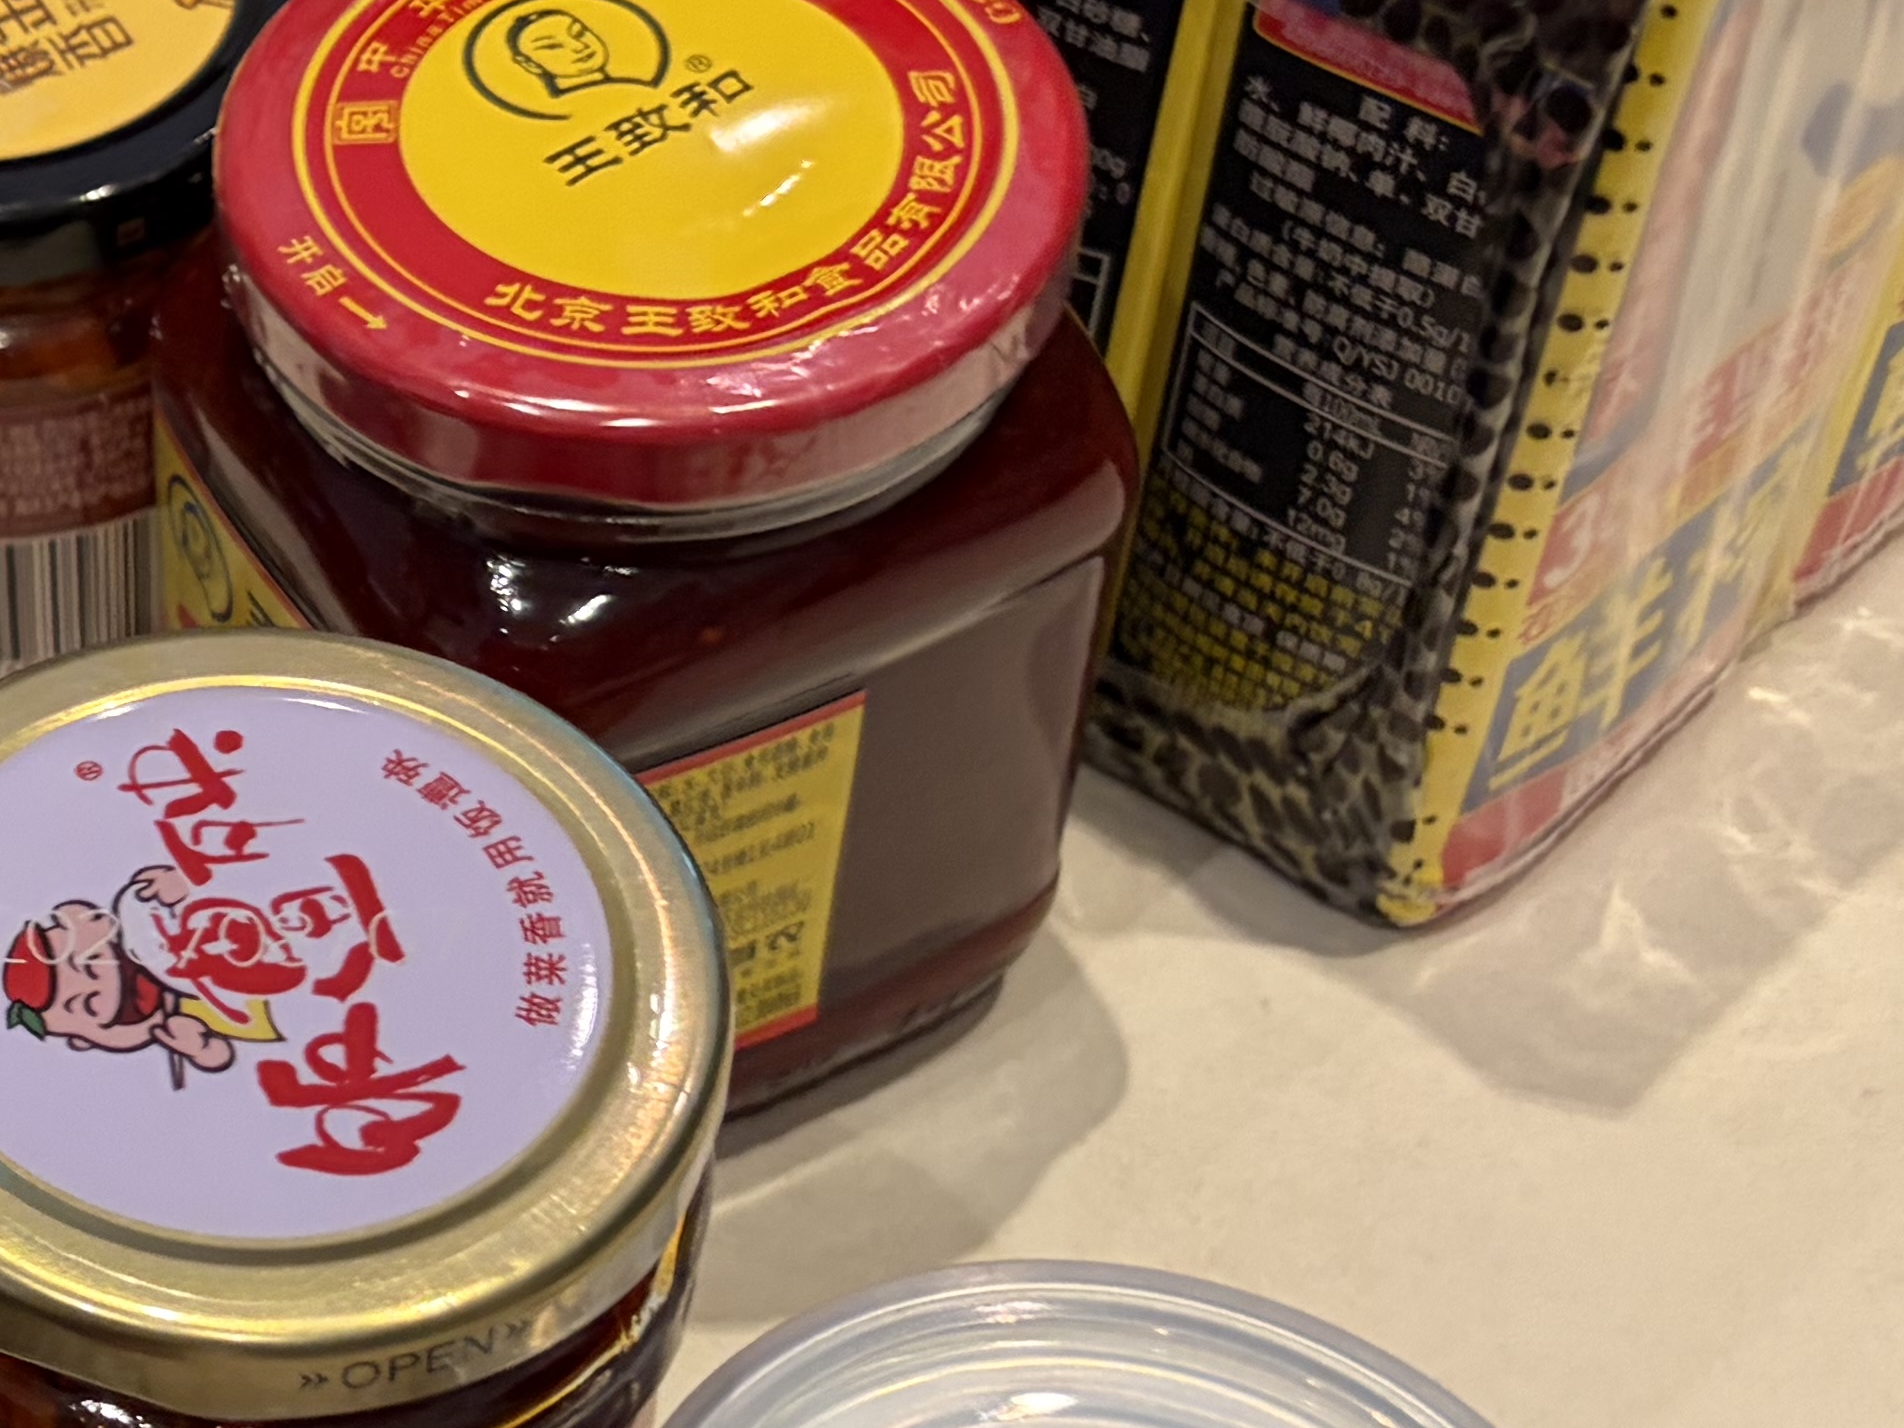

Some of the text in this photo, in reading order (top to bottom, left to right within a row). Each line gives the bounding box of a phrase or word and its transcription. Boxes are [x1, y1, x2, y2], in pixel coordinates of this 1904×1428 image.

[484, 66, 959, 340] 北京王致和食品有限公司
[544, 66, 757, 188] 王致和
[379, 743, 571, 1029] 做菜香就用饭遭殃
[341, 1326, 501, 1395] OPEN
